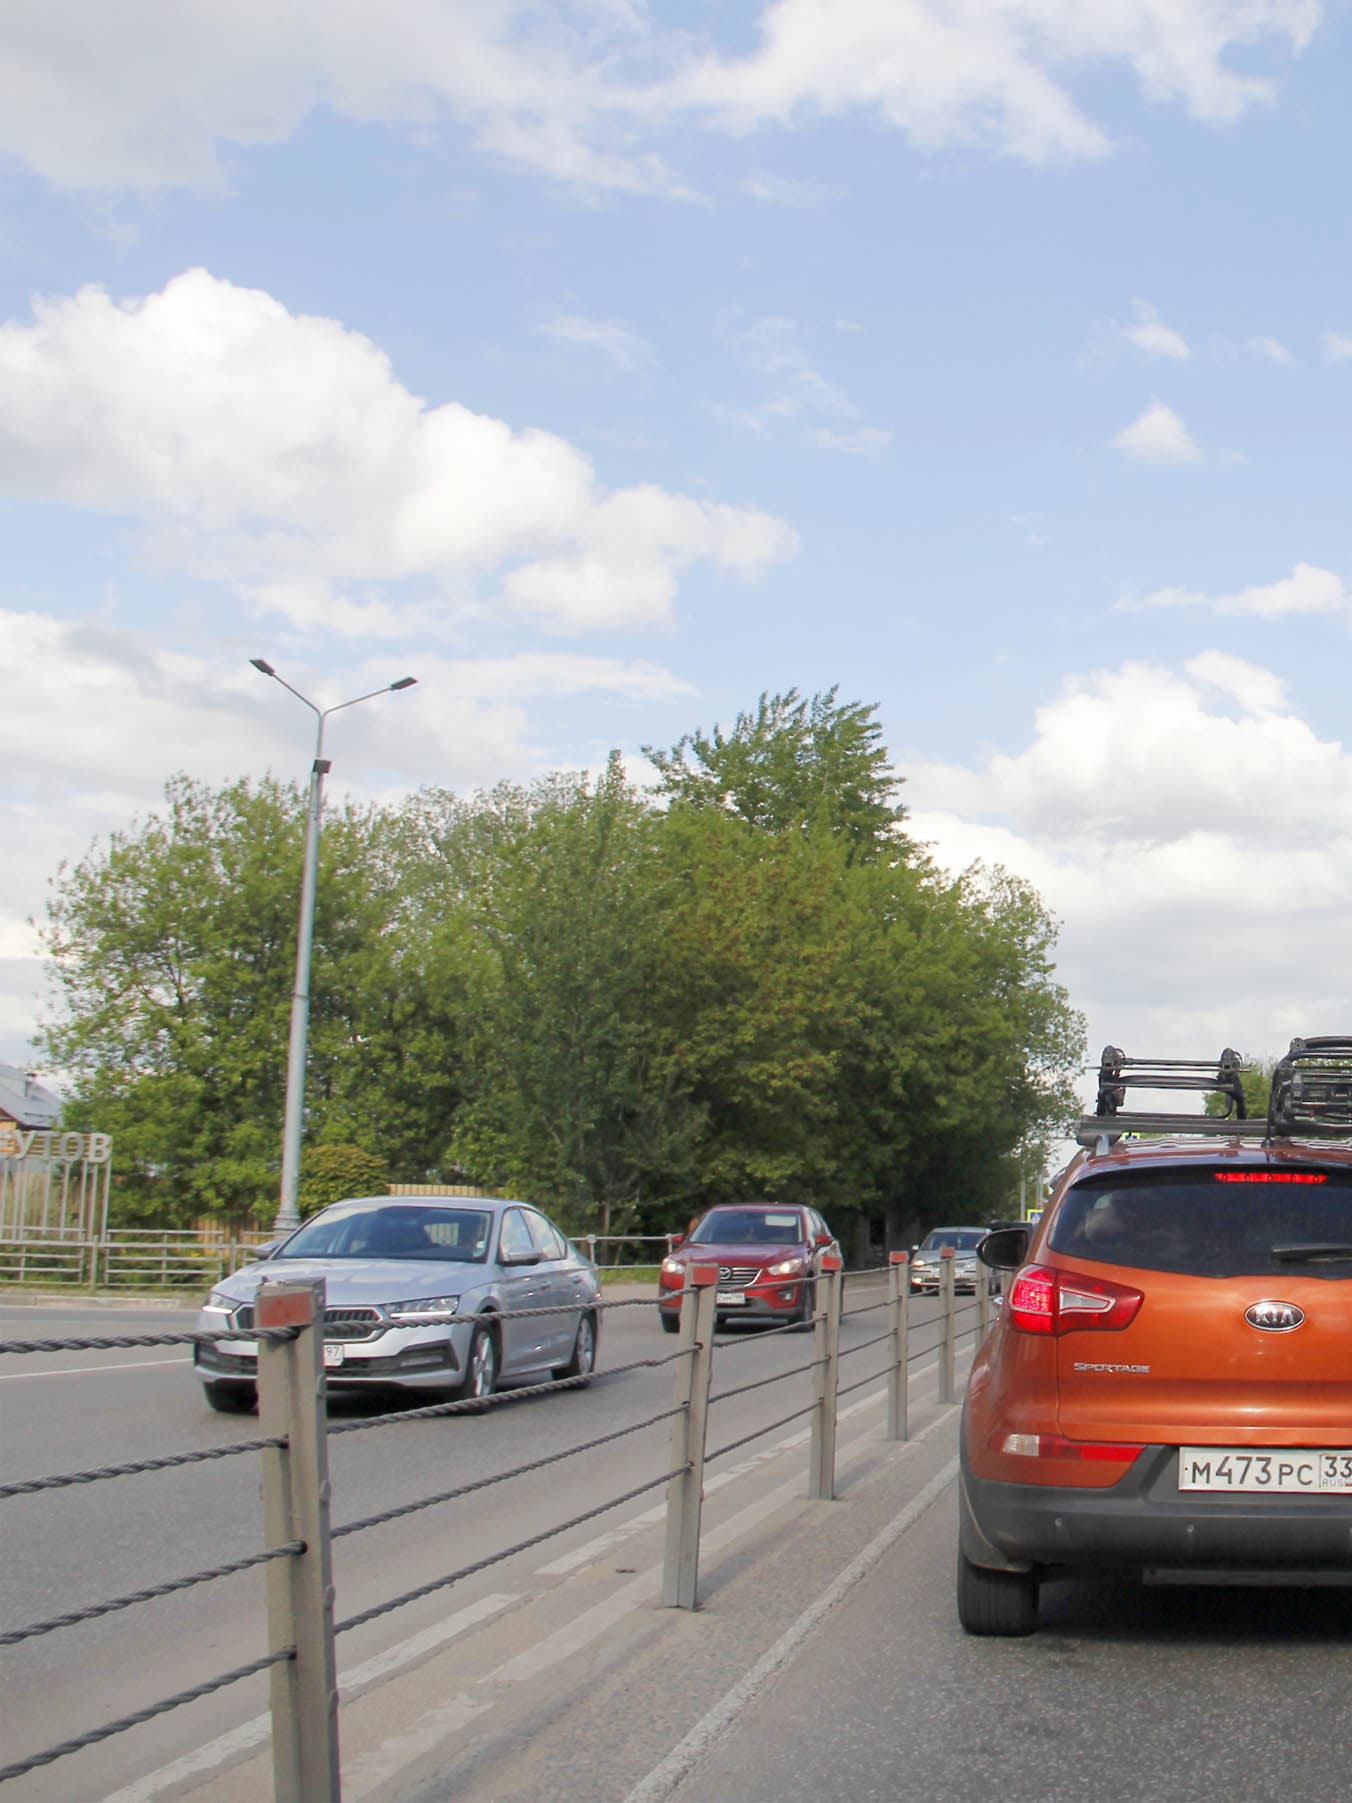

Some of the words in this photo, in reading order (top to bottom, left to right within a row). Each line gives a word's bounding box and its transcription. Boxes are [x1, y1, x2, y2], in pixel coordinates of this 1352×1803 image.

[1254, 1307, 1296, 1324] KIA
[1073, 1362, 1152, 1374] SPORTAGE
[1191, 1455, 1313, 1485] М473РС
[1321, 1478, 1345, 1488] RUS
